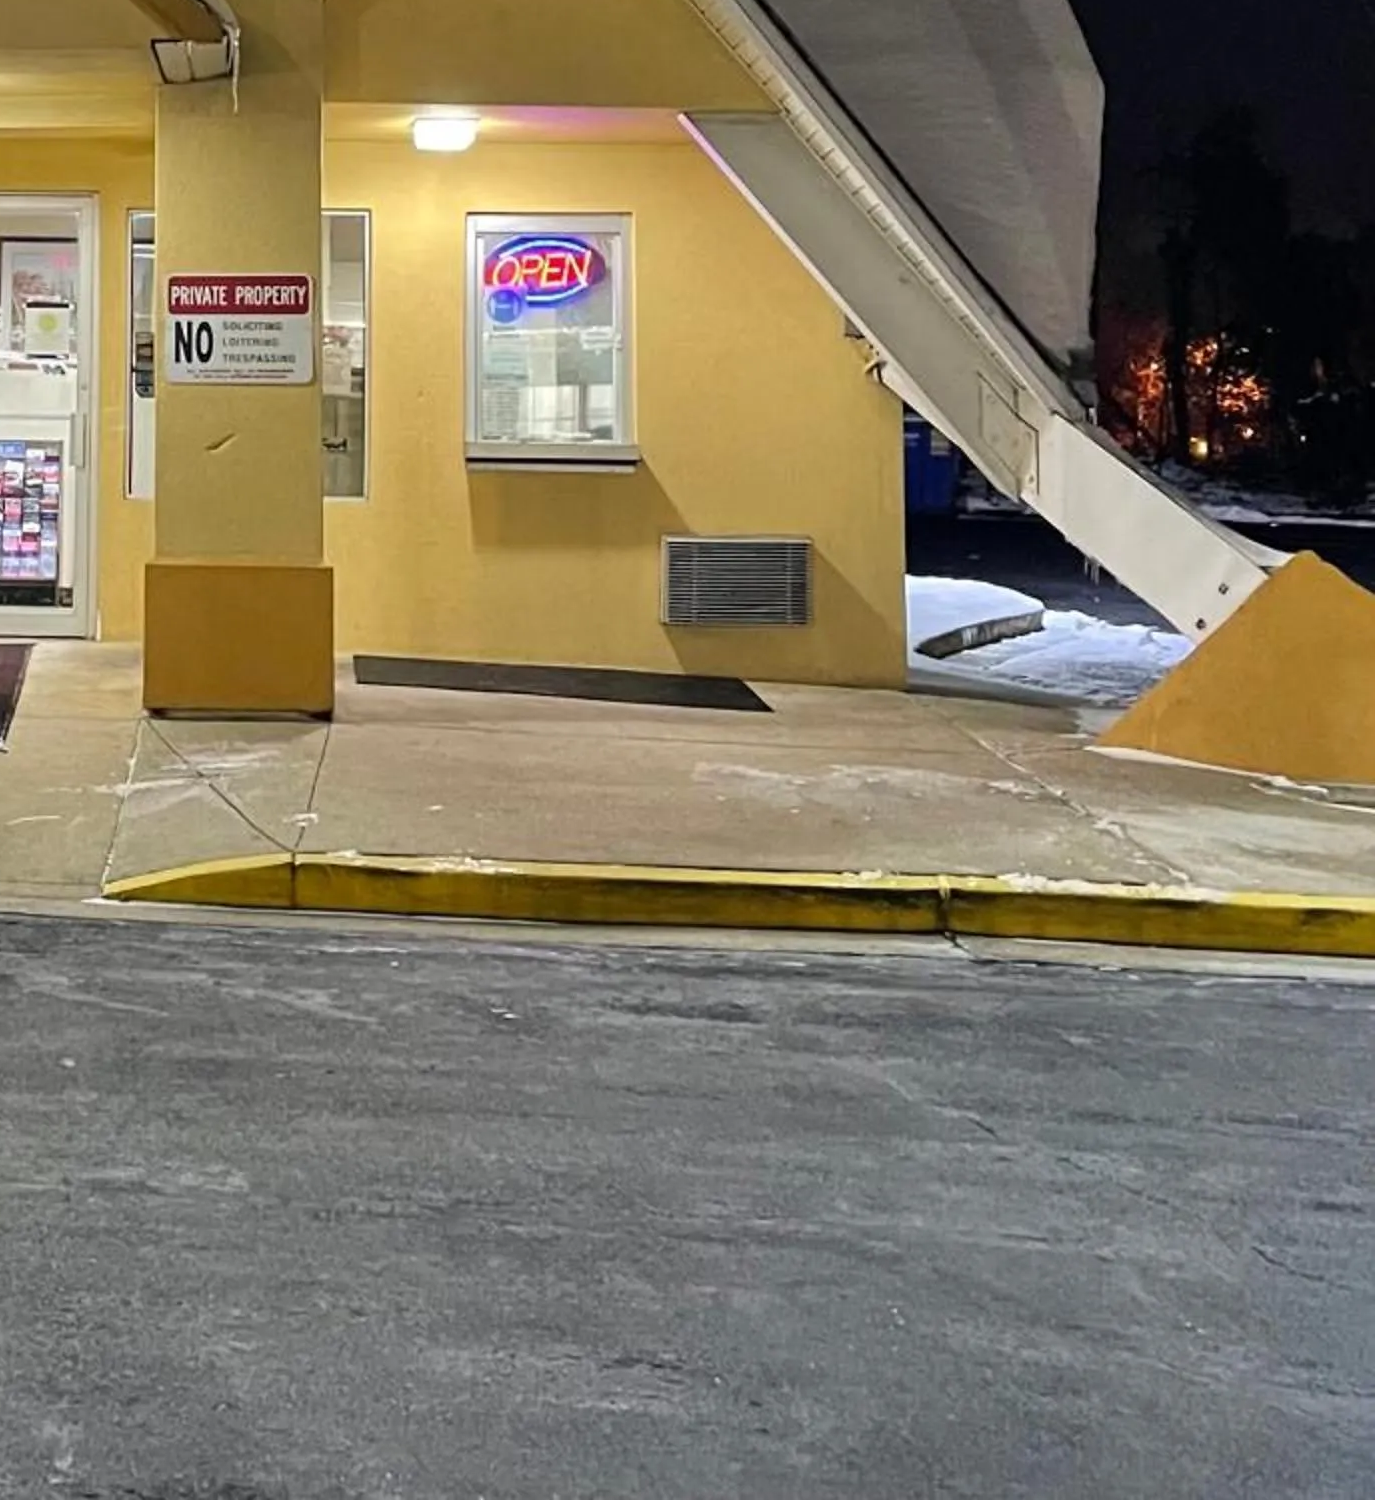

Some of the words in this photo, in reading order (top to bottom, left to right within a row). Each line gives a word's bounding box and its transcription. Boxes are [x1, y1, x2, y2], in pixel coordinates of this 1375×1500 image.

[492, 250, 592, 288] OPEN
[171, 285, 228, 305] PRIVATE
[235, 285, 306, 305] PROPERTY
[222, 321, 284, 331] SOLICITING
[174, 321, 214, 364] NO
[222, 337, 280, 347] LOITERING
[222, 354, 297, 363] TRESPASSING
